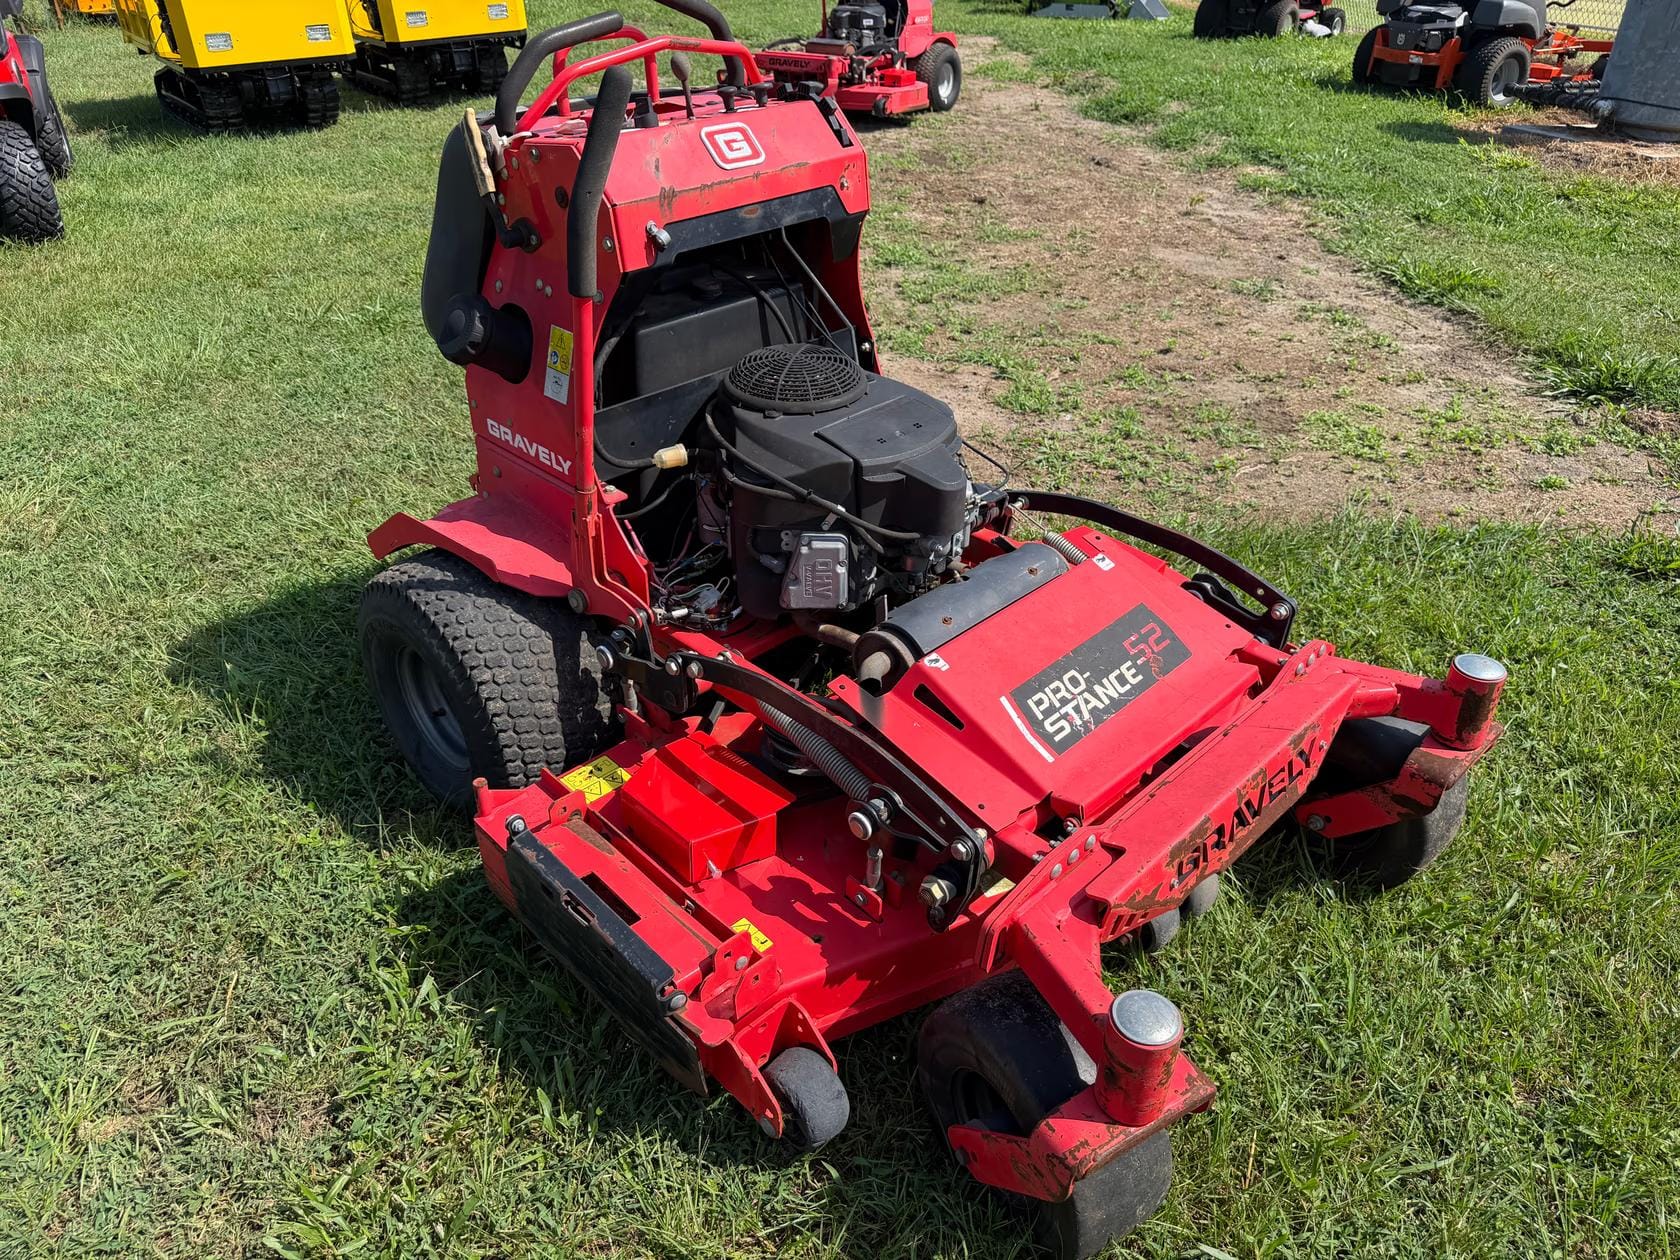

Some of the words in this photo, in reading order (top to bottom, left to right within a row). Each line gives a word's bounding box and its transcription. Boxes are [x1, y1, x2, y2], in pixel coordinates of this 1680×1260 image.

[768, 57, 811, 69] GRAVELY
[714, 131, 752, 160] G
[486, 418, 573, 475] GRAVELY
[1122, 622, 1171, 665] 52
[1027, 669, 1091, 720] PRO-
[1043, 660, 1144, 743] STANCE
[1176, 736, 1318, 886] GRAVELY
